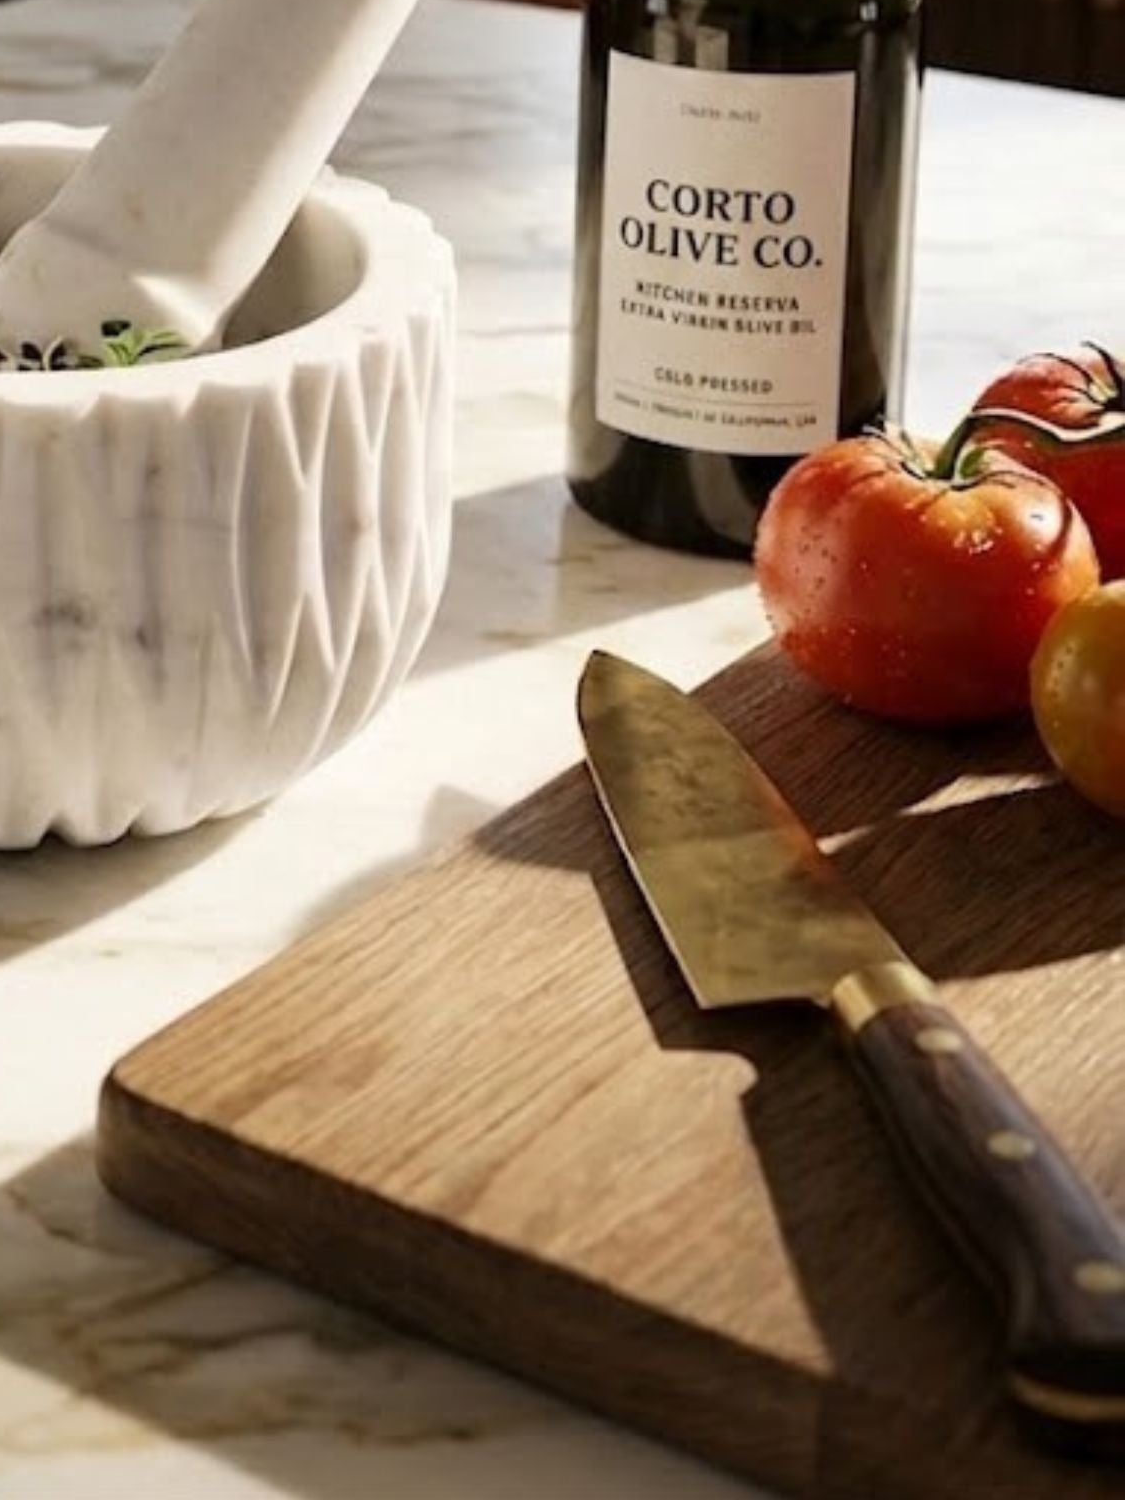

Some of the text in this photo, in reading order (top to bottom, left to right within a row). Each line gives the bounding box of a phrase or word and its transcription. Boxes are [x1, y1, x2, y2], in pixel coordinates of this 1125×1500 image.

[645, 178, 795, 225] CORTO
[620, 216, 824, 269] OLIVE CO.
[716, 293, 800, 311] RESERVA
